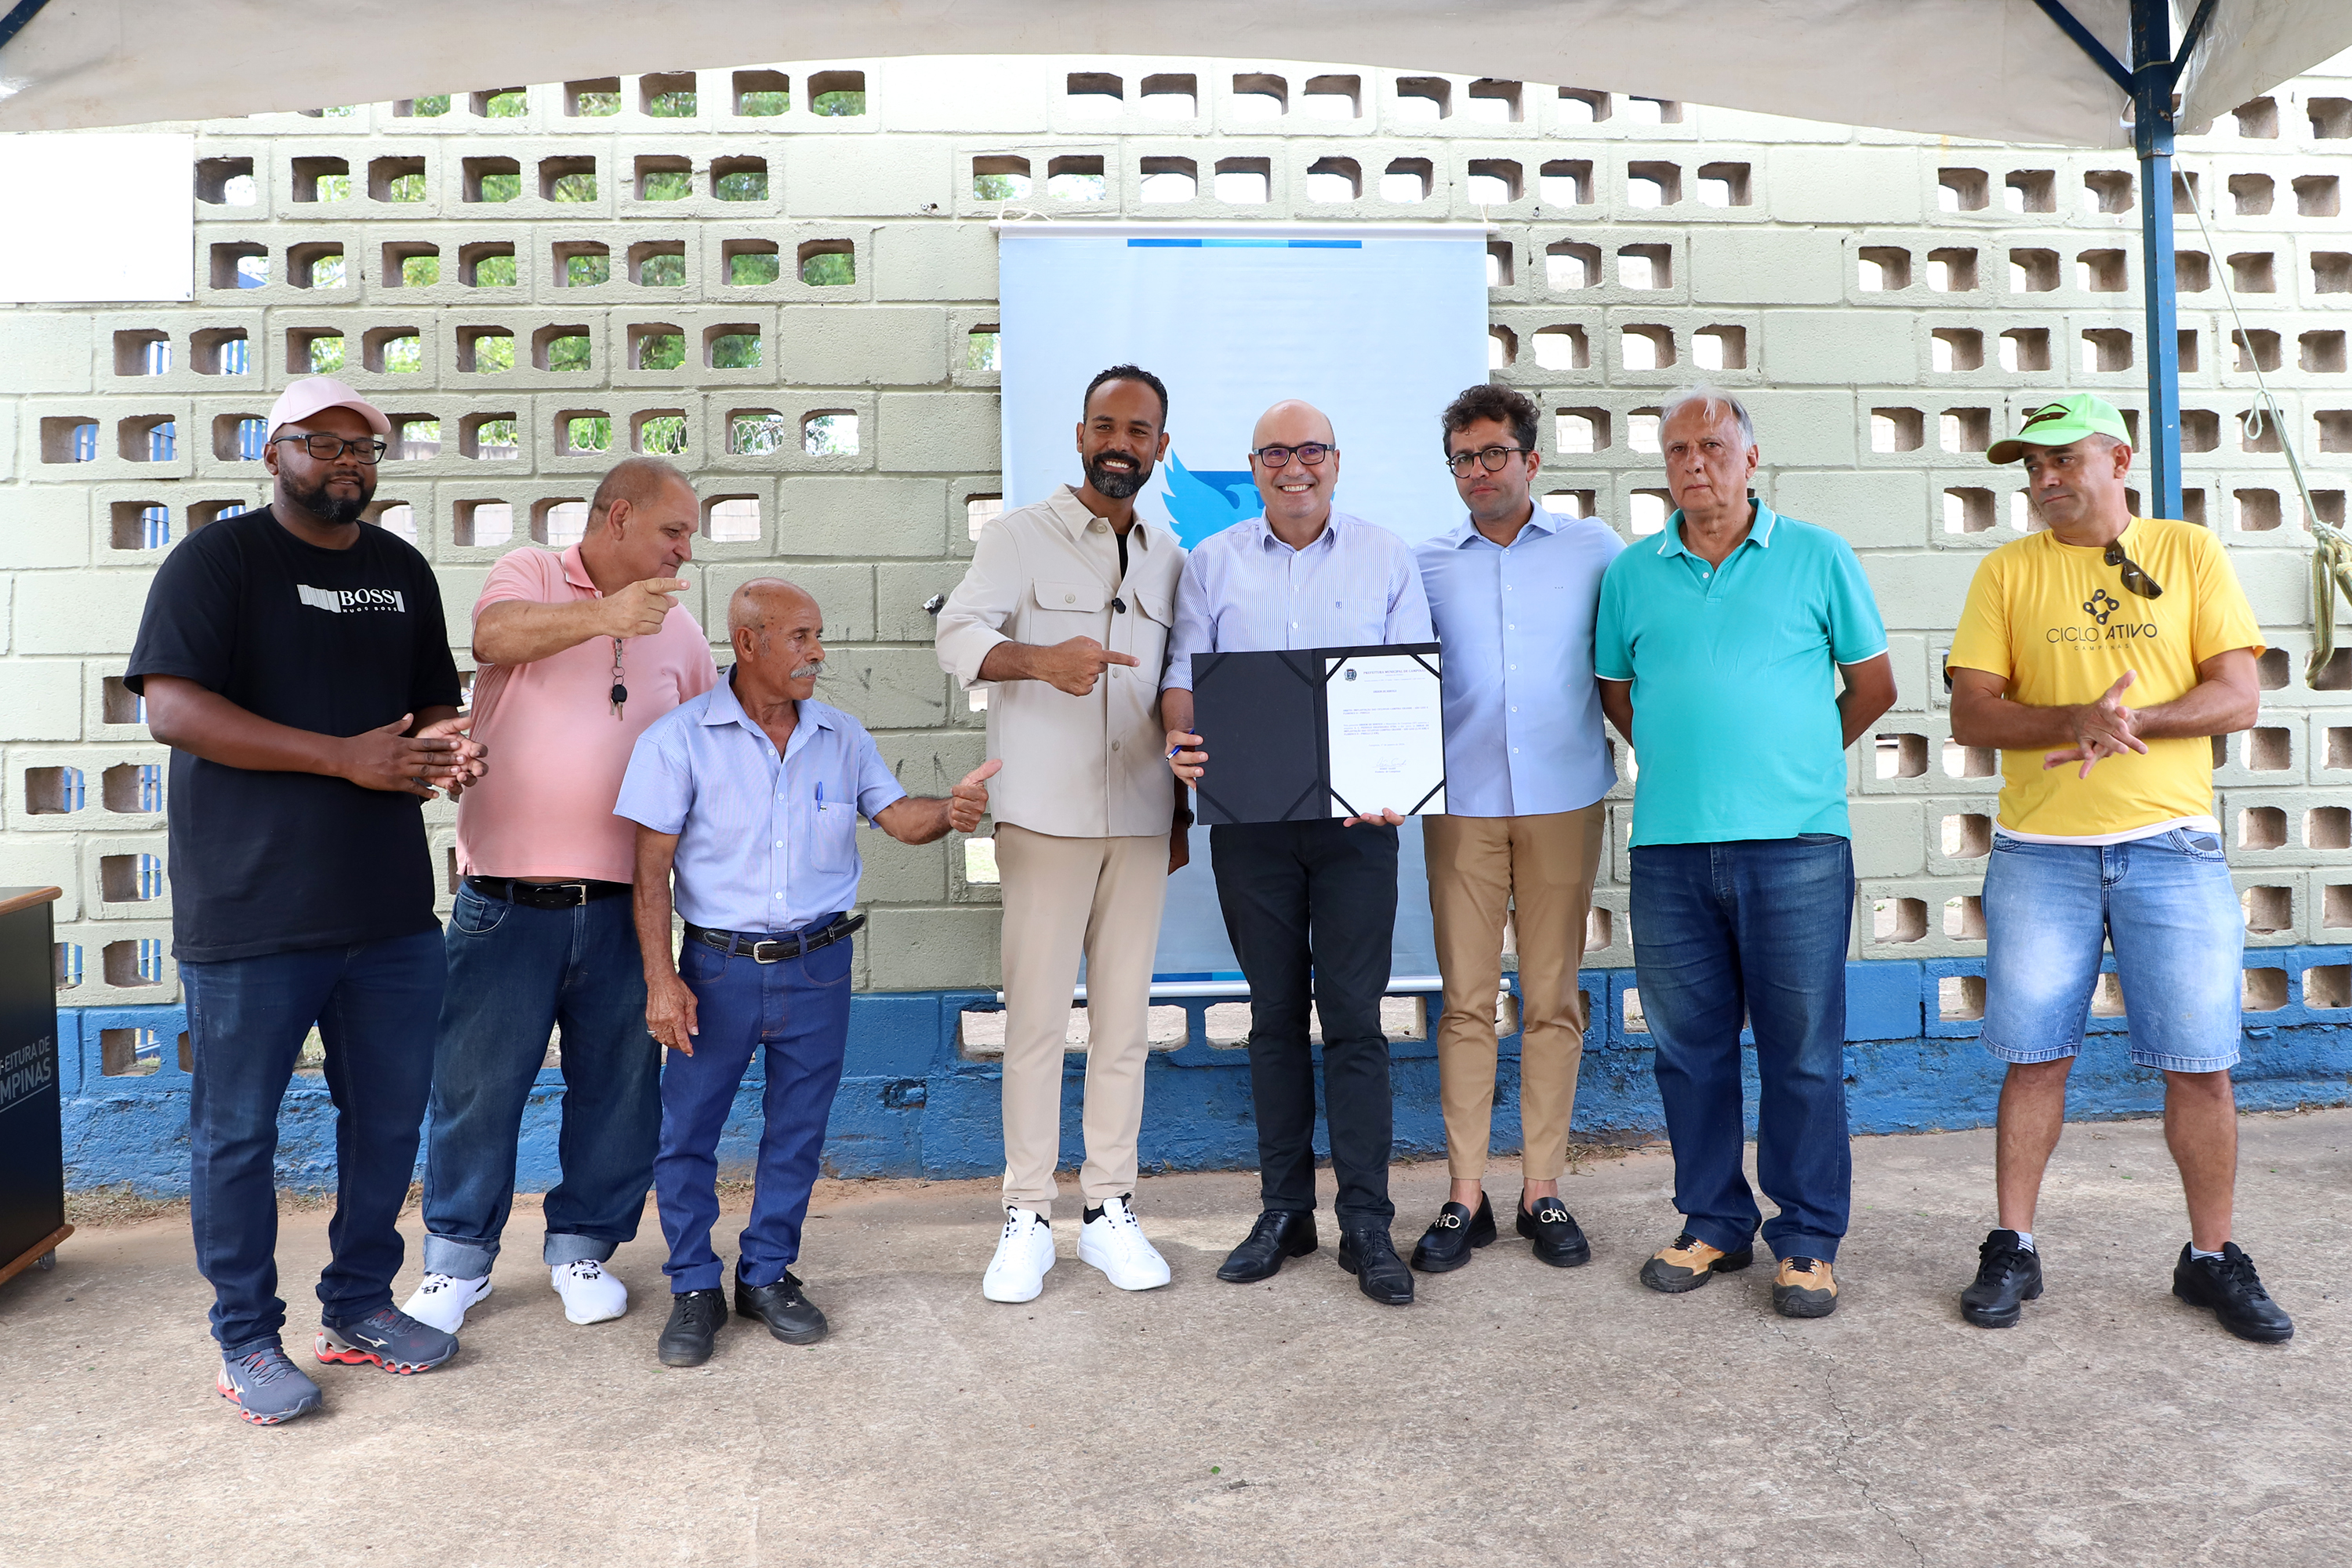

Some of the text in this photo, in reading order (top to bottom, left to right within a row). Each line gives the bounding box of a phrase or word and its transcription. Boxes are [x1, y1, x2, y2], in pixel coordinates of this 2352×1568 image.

[339, 588, 395, 606] BOSS
[2046, 623, 2158, 644] CICLO ATIVO
[2074, 643, 2129, 652] CAMPINAS
[38, 1035, 51, 1056] DE
[0, 1057, 51, 1105] MPINAS
